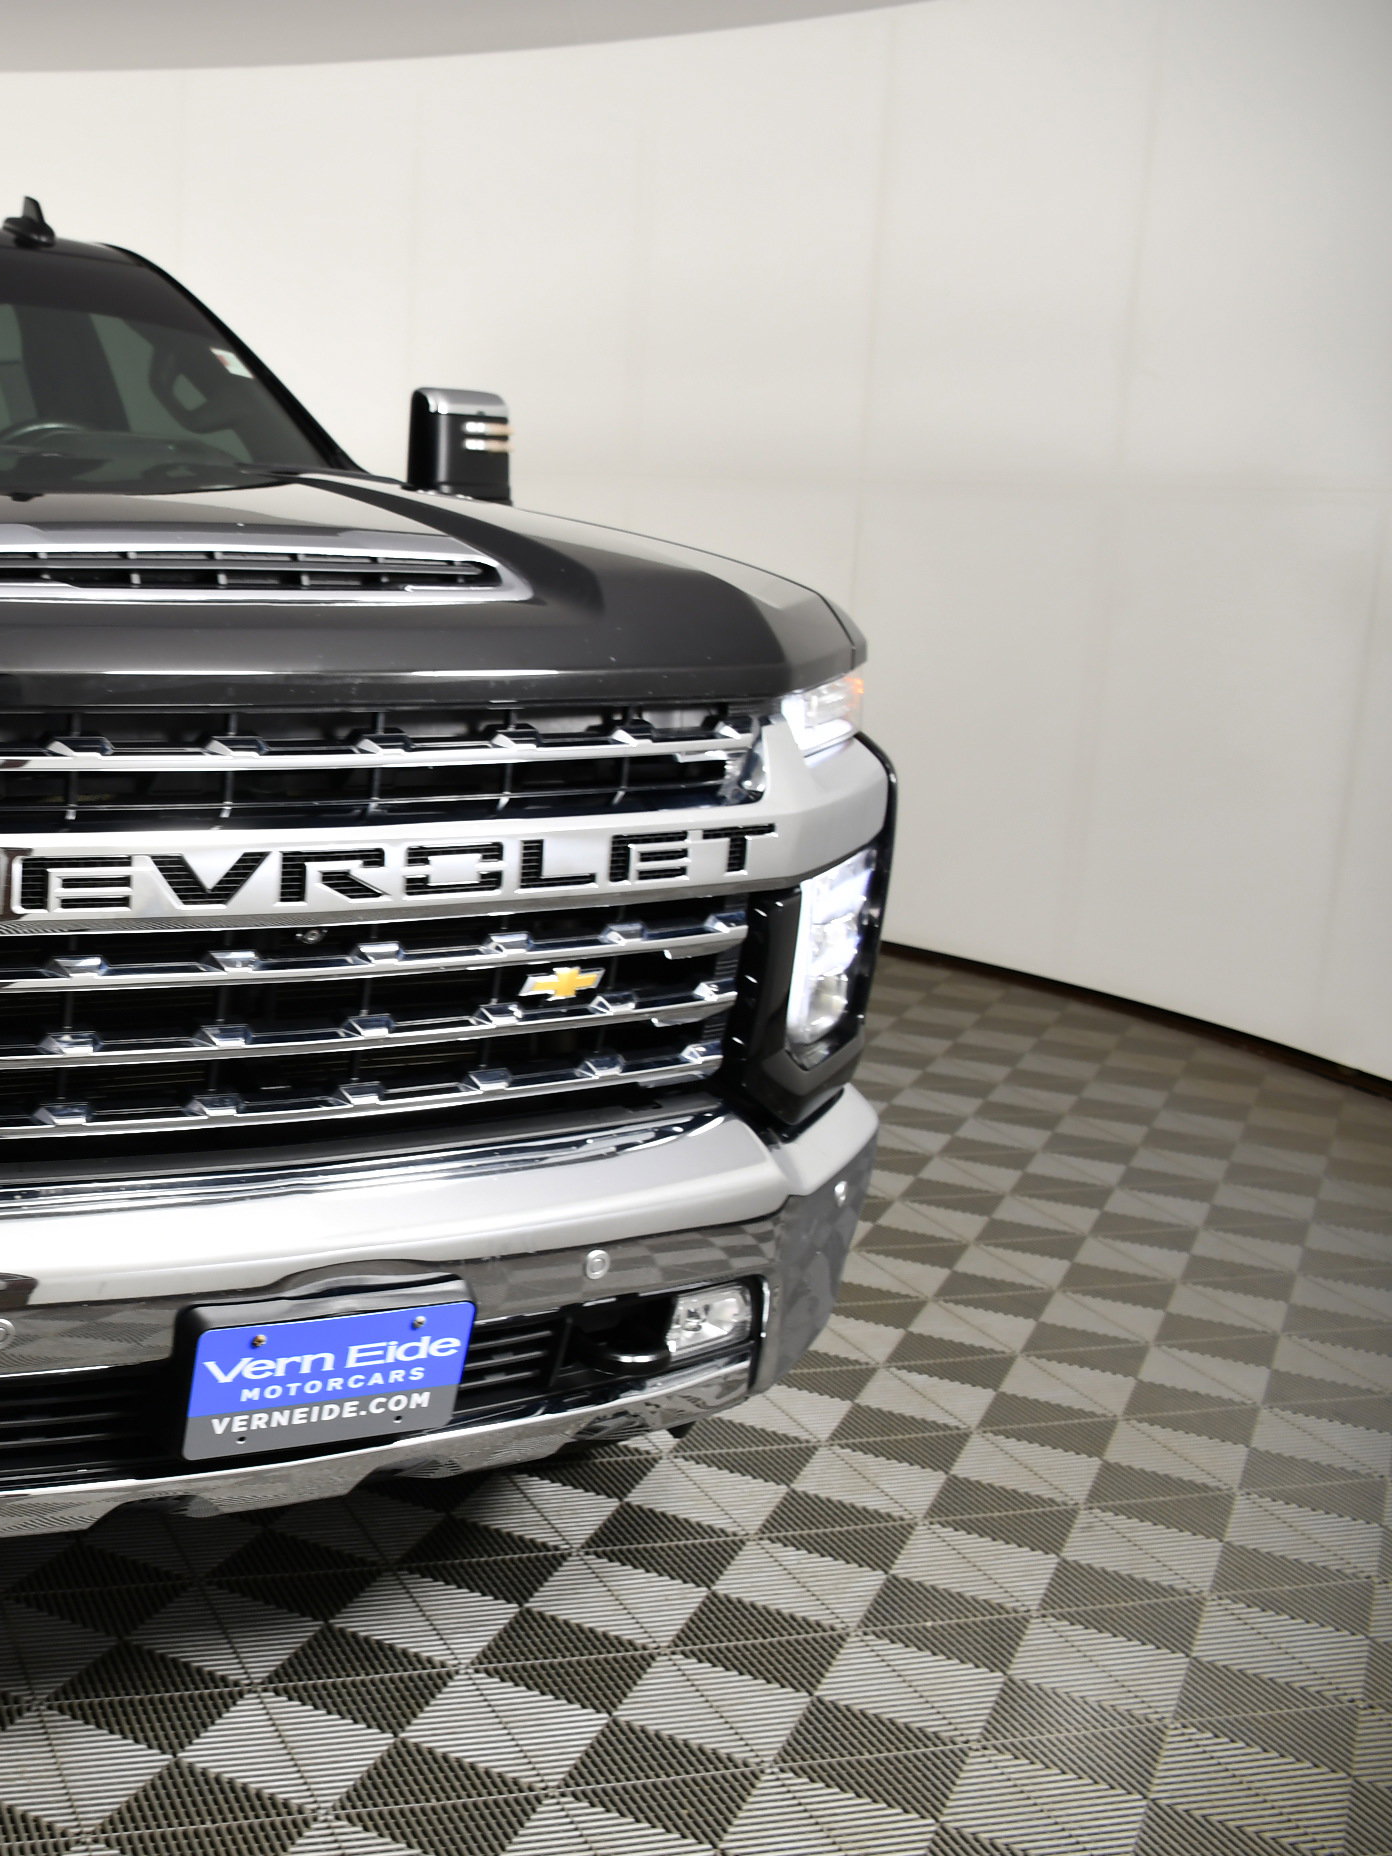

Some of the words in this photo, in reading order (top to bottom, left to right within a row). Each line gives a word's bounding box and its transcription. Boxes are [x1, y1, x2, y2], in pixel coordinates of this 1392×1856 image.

[202, 1350, 334, 1384] Vern
[345, 1335, 461, 1369] Eide
[239, 1366, 426, 1402] MOTORCARS
[210, 1391, 431, 1435] VERNEIDE.COM
